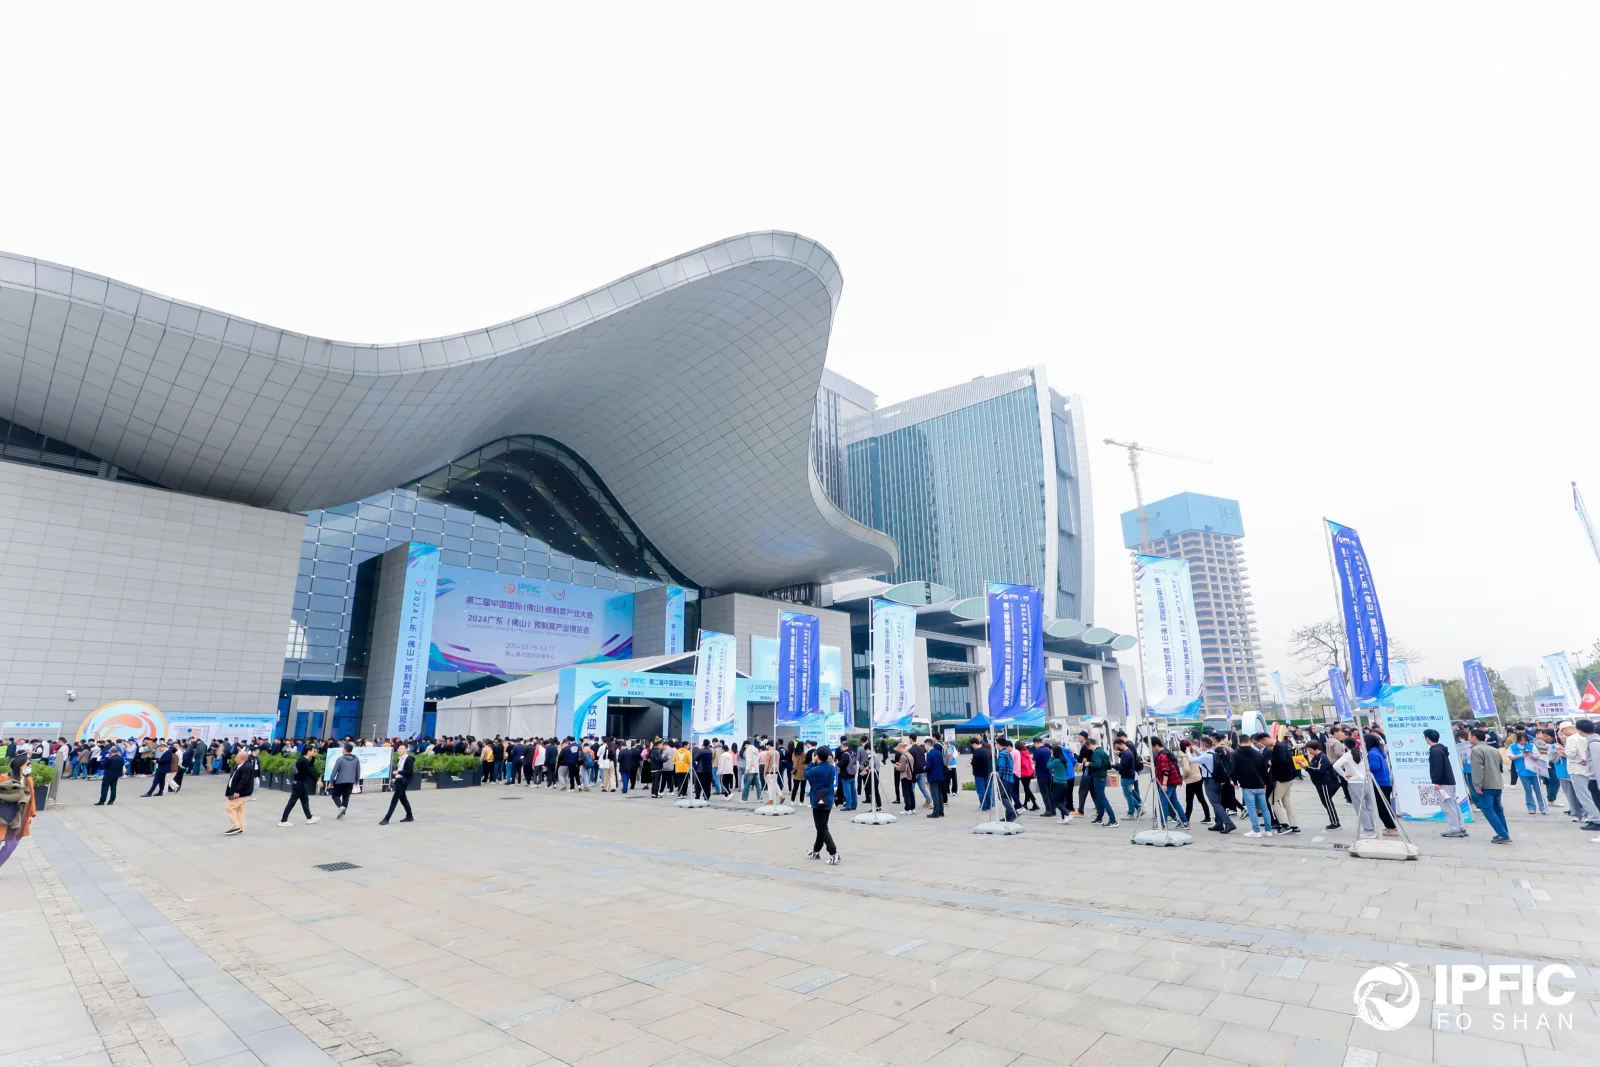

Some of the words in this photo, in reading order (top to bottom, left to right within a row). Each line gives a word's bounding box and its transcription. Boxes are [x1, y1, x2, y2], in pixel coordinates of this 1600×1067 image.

[398, 590, 421, 732] 2024广东（佛山）预制菜产业博览会
